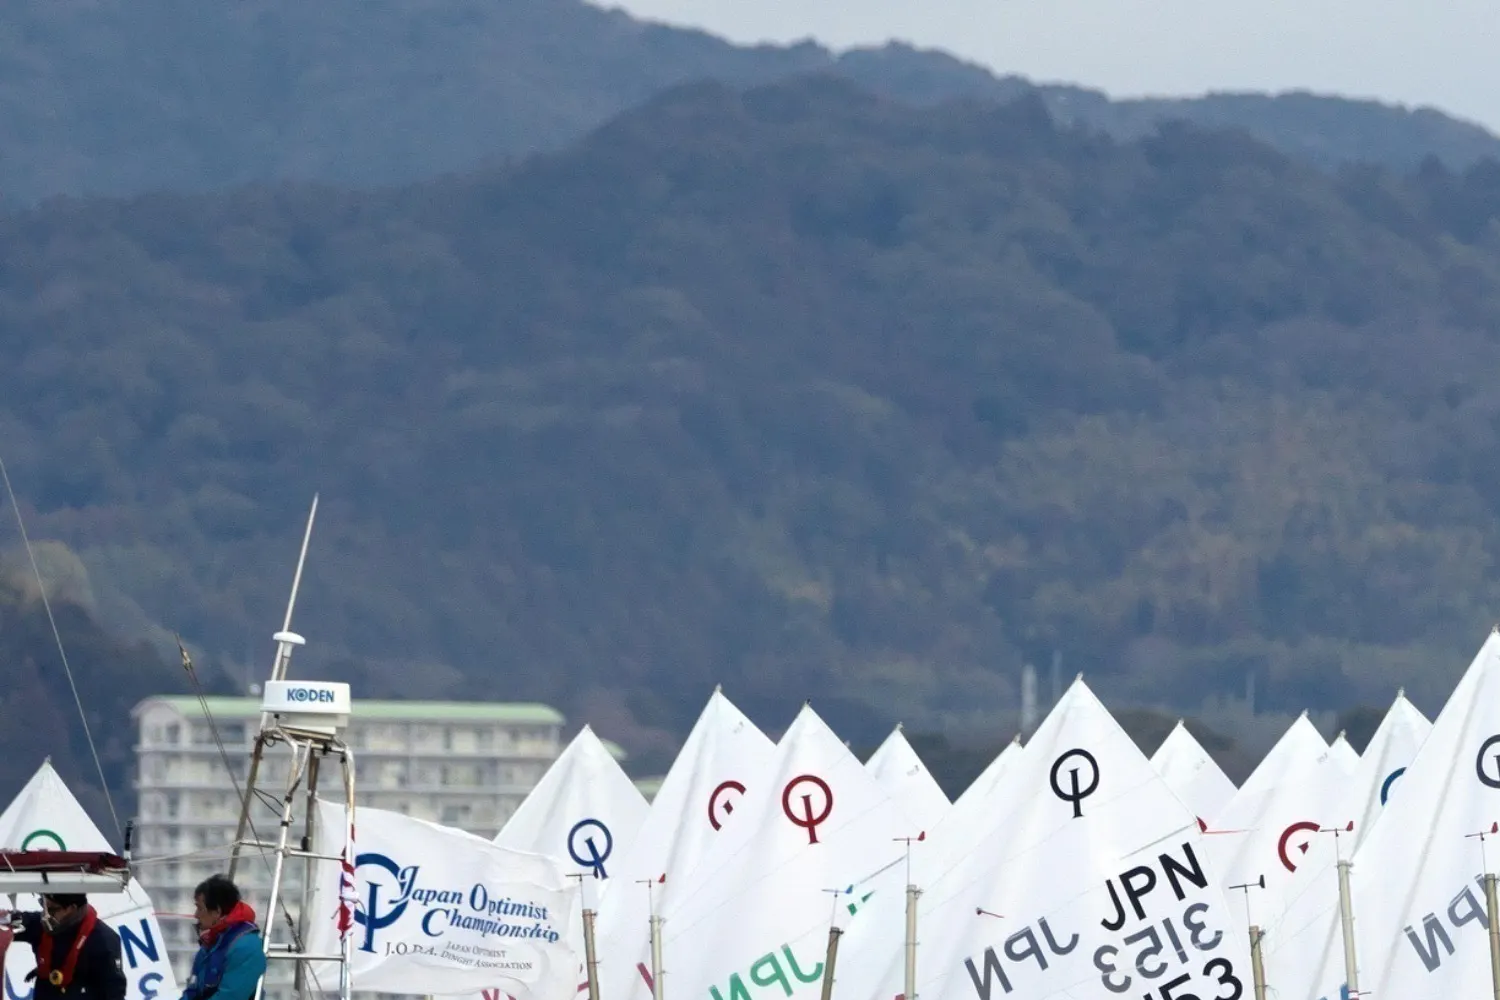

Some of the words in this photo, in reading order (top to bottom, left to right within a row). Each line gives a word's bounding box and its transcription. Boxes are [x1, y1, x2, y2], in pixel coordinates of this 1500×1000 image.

[287, 688, 334, 702] KODEN
[388, 865, 463, 907] Japan
[469, 883, 548, 920] Optimist
[1100, 842, 1208, 931] JPN
[421, 907, 559, 943] Championship
